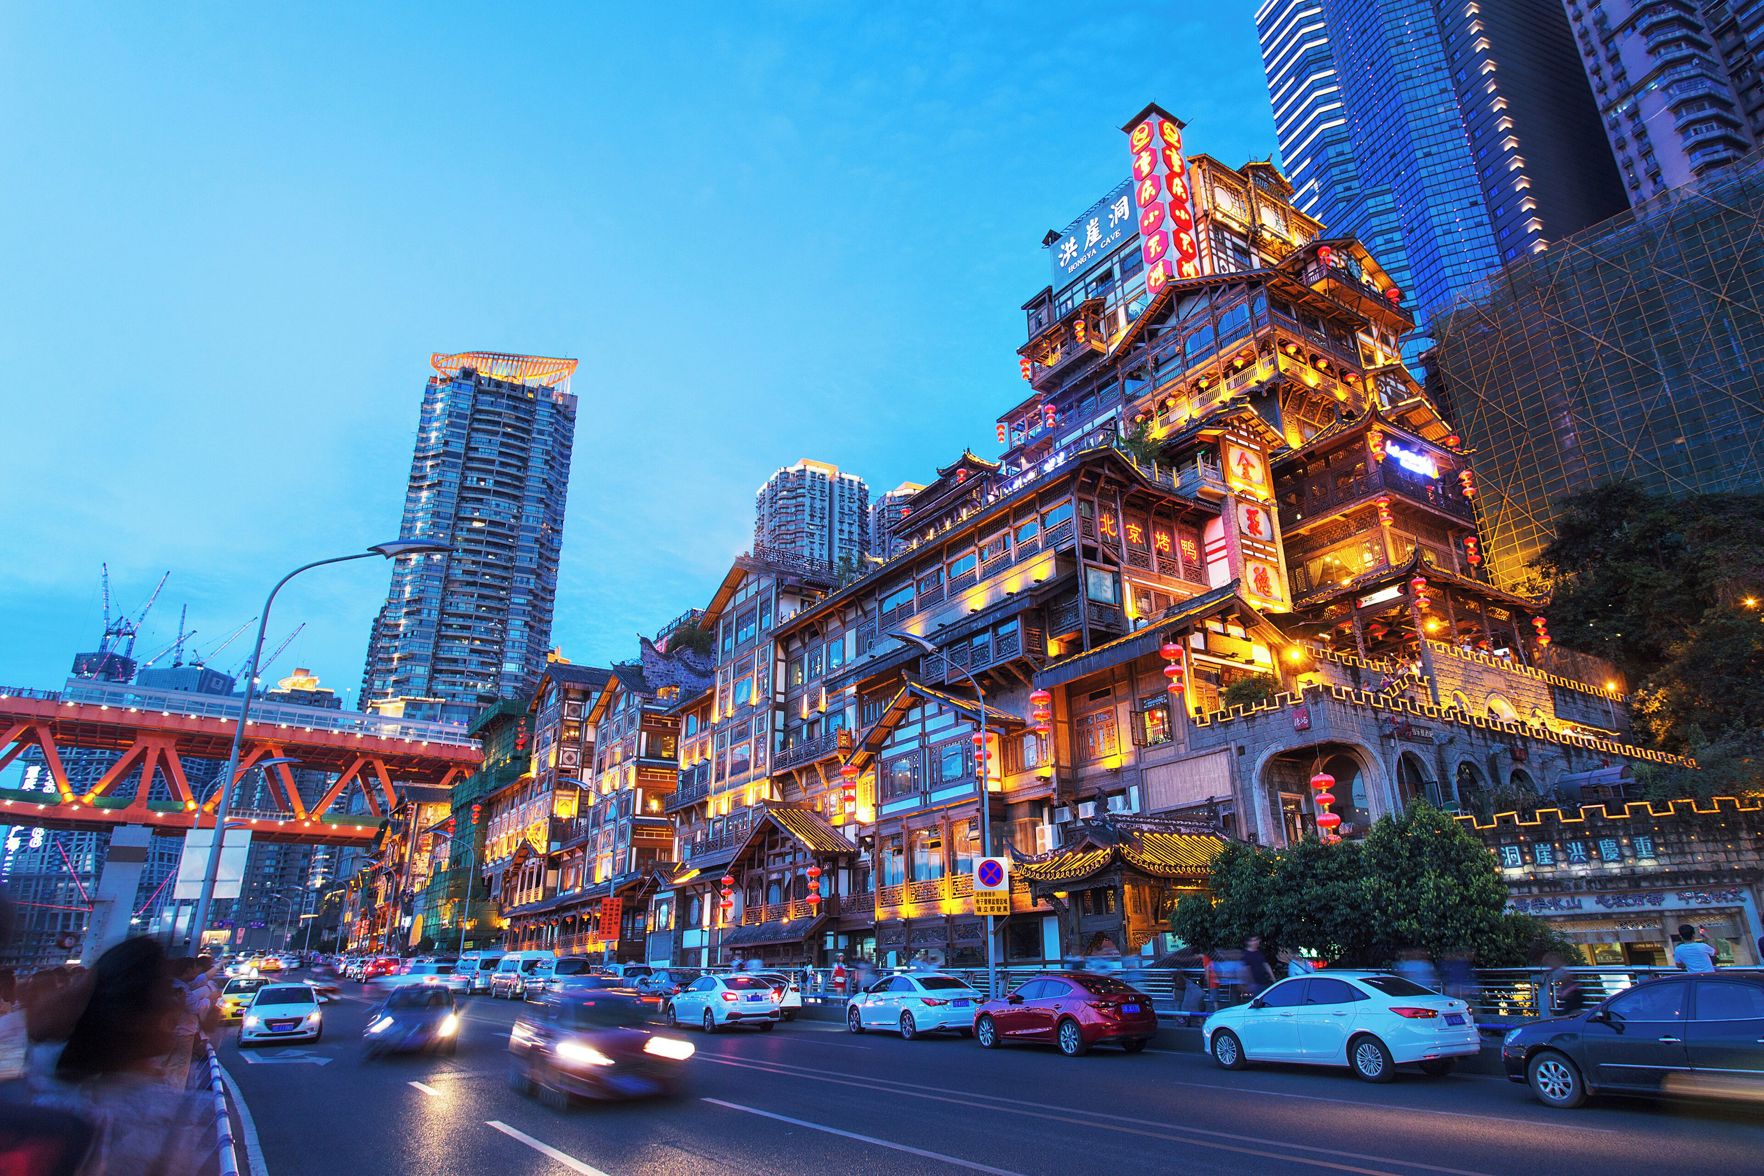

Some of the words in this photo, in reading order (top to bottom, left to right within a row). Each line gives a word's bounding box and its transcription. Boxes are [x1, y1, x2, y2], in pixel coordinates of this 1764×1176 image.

[1058, 195, 1130, 268] 洪崖洞
[1067, 248, 1097, 274] HONGYA
[1100, 228, 1121, 249] CAVE
[1099, 512, 1197, 561] 北京烤鸭
